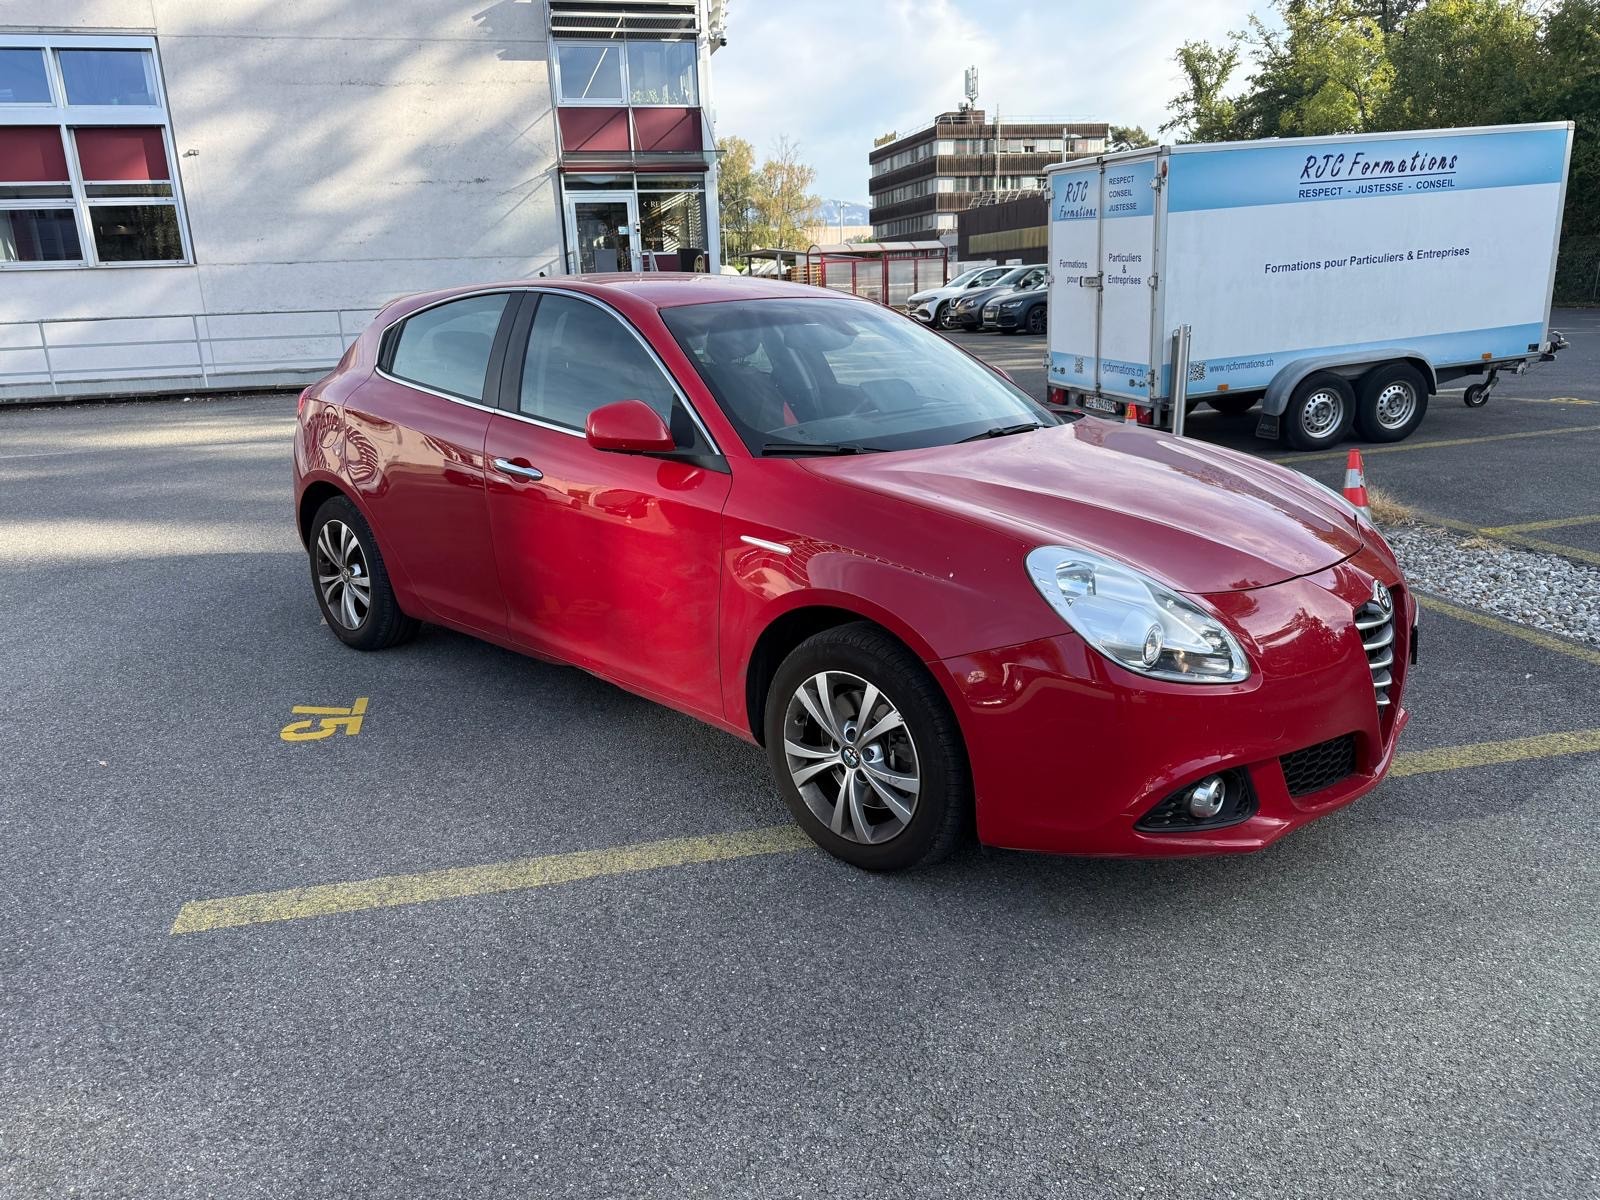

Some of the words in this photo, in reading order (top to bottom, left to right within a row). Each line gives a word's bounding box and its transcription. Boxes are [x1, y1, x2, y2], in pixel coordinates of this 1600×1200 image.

[1300, 153, 1345, 179] RJC
[1348, 150, 1458, 176] Formations
[1108, 175, 1135, 186] RESPECT
[1064, 180, 1089, 203] RJC
[1108, 187, 1133, 198] CONSEIL
[1298, 186, 1343, 199] RESPECT
[1355, 182, 1404, 195] JUSTESSE
[1416, 179, 1455, 190] CONSEIL
[1059, 205, 1097, 218] Formations
[1108, 202, 1137, 212] JUSTESSE
[1108, 252, 1142, 263] Particuliers
[1264, 260, 1322, 274] Formations
[1324, 257, 1347, 270] pour
[1349, 251, 1404, 266] Particuliers
[1406, 250, 1414, 260] &
[1416, 247, 1470, 260] Entreprises
[1059, 259, 1088, 269] Formations
[1121, 264, 1127, 274] &
[1066, 275, 1079, 284] pour
[1107, 274, 1142, 286] Entreprises
[1209, 357, 1274, 373] www.rjcformations.ch
[280, 697, 369, 742] 15
